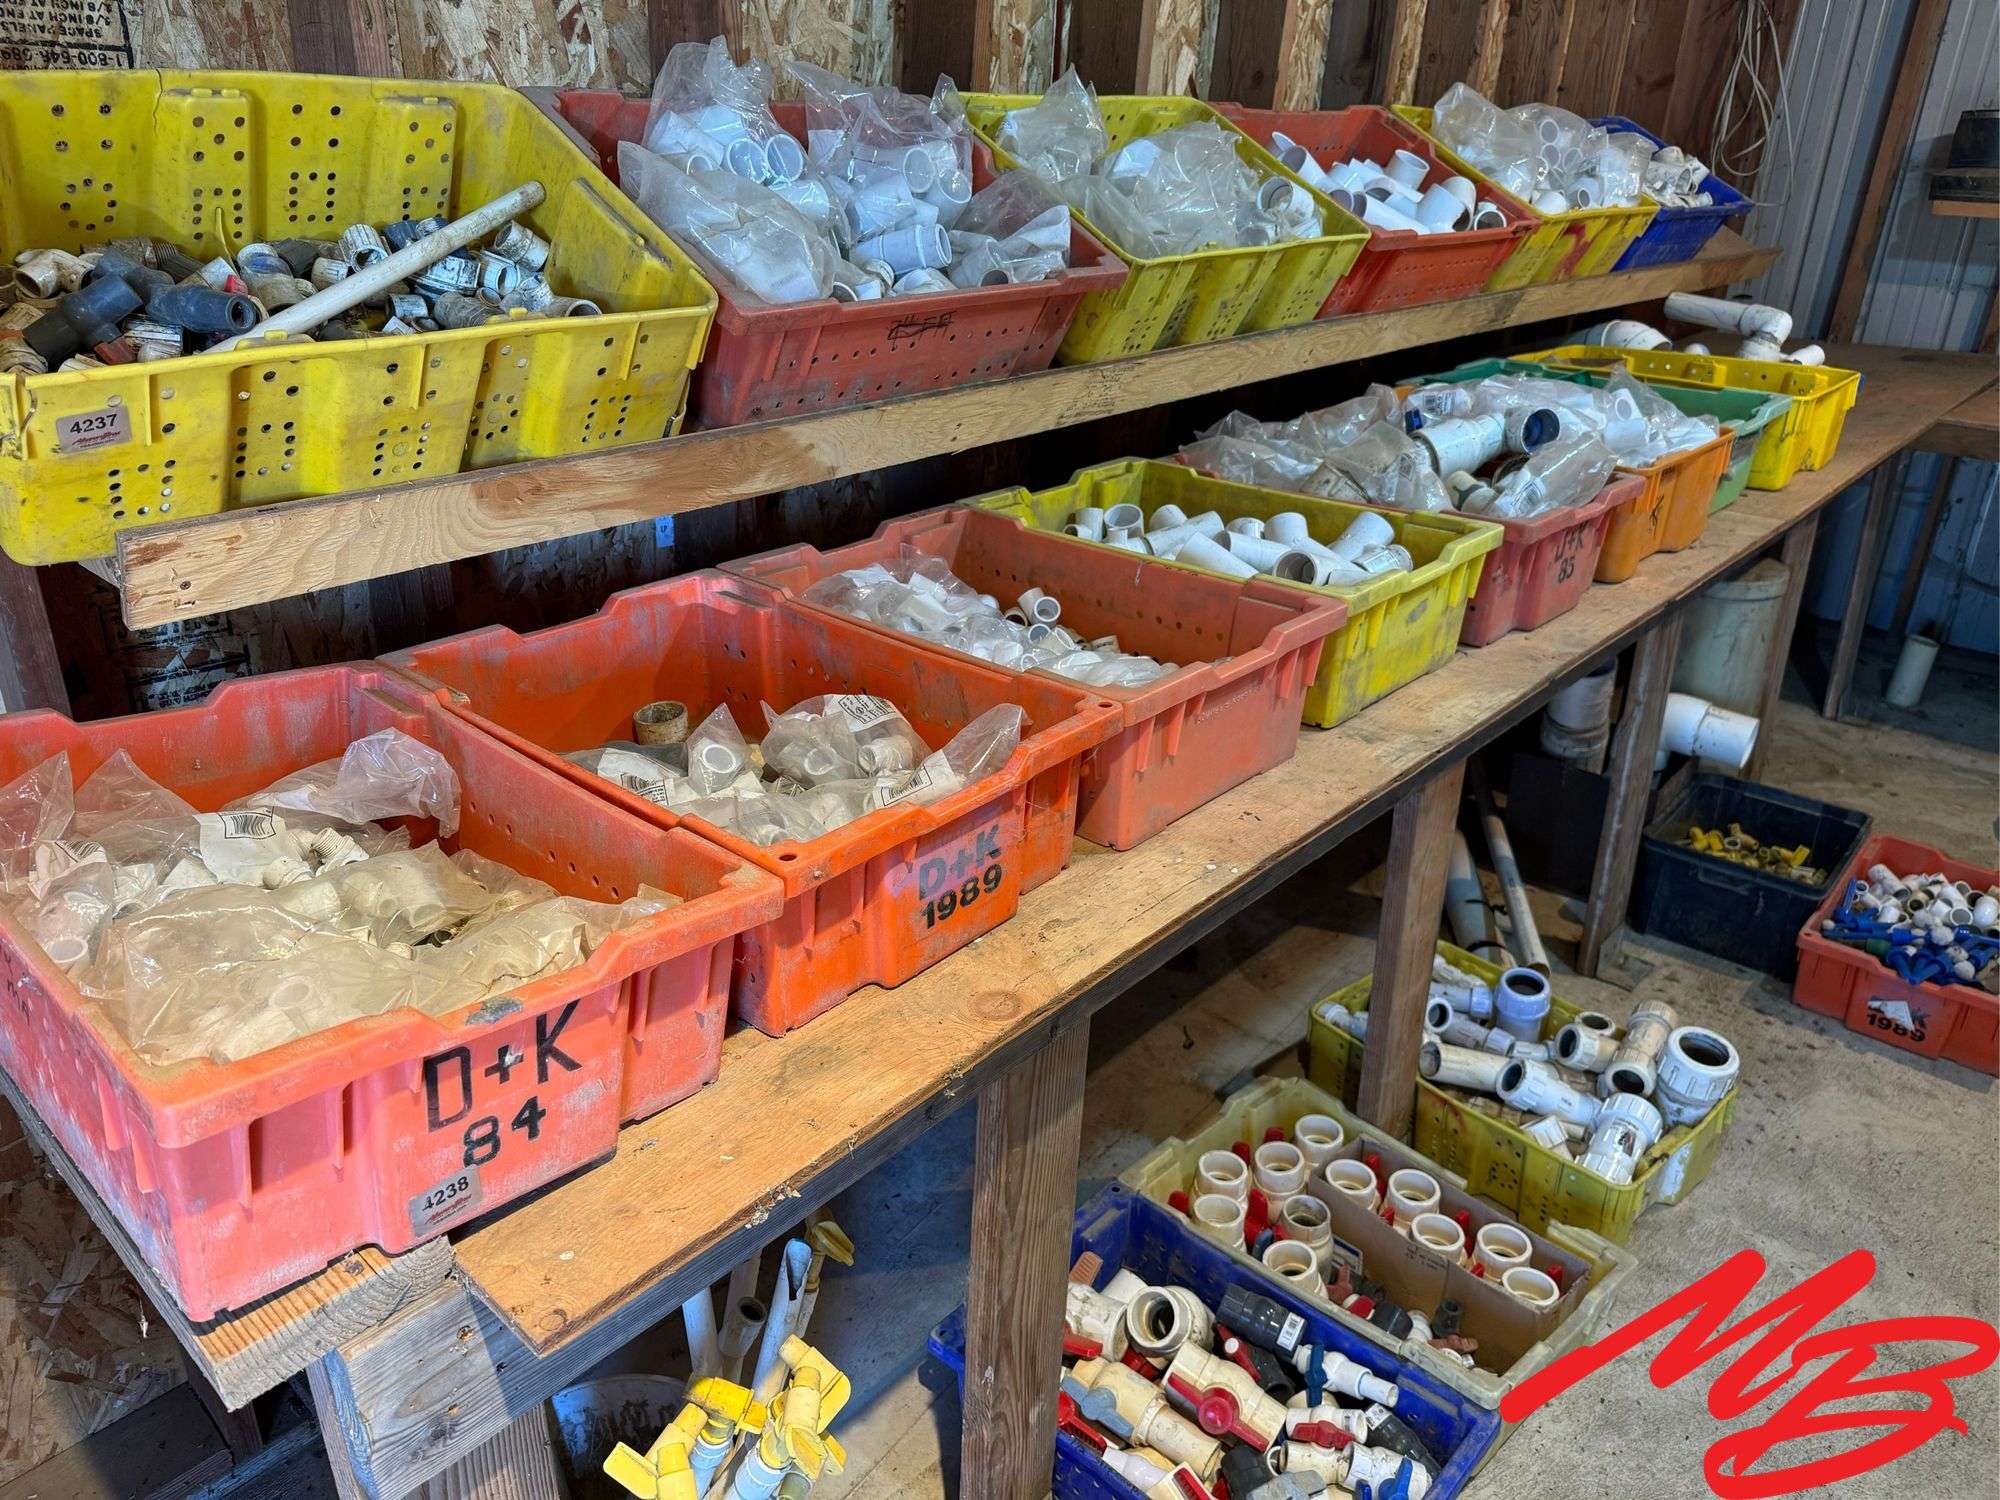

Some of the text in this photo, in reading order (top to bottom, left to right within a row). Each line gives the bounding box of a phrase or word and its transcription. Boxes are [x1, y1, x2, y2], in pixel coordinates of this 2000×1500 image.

[70, 413, 118, 434] 4237
[919, 824, 1001, 900] D+K
[920, 864, 1002, 929] 1989
[424, 999, 583, 1132] D+K
[463, 1096, 546, 1168] 84
[421, 1176, 469, 1211] 4238
